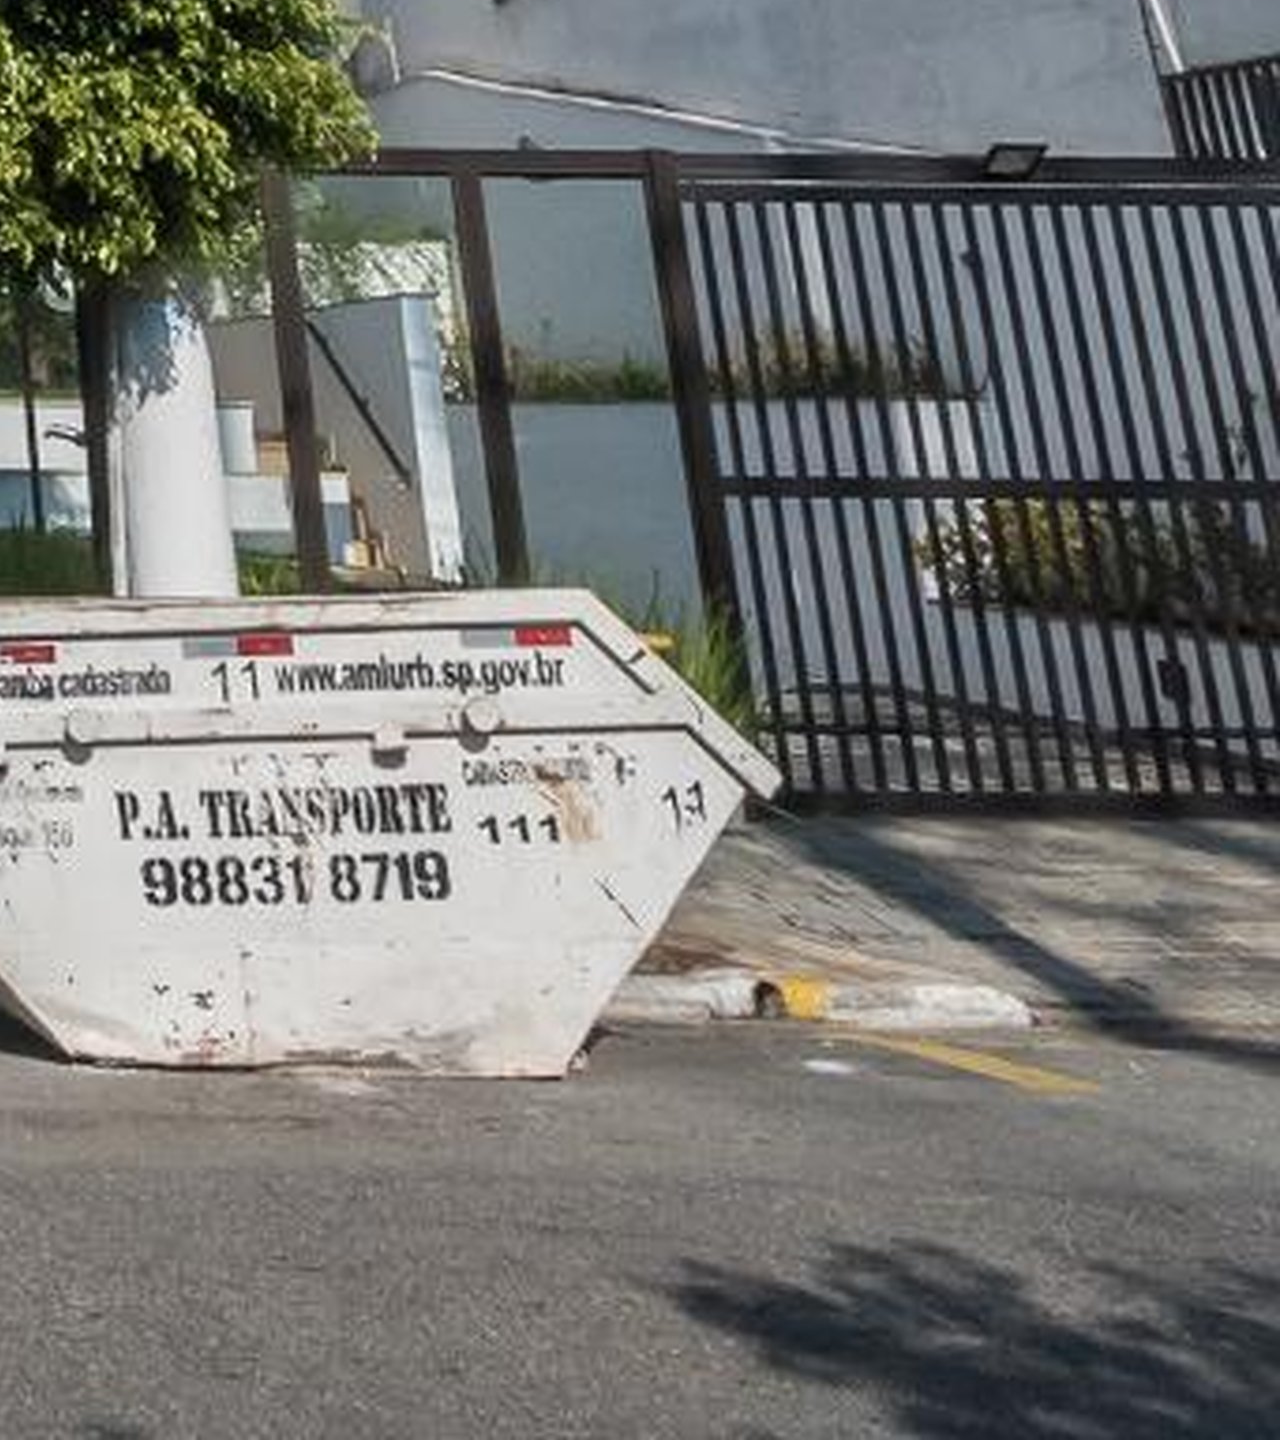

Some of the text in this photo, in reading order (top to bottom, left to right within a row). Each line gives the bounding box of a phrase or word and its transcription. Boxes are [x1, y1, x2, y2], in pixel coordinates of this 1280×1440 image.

[210, 660, 260, 703] 11
[274, 649, 565, 694] www.amlurb.sp.gov.br
[114, 790, 190, 840] P.A.
[198, 782, 453, 839] TRANSPORTE
[477, 814, 560, 845] 111
[140, 849, 452, 906] 98831 8719
